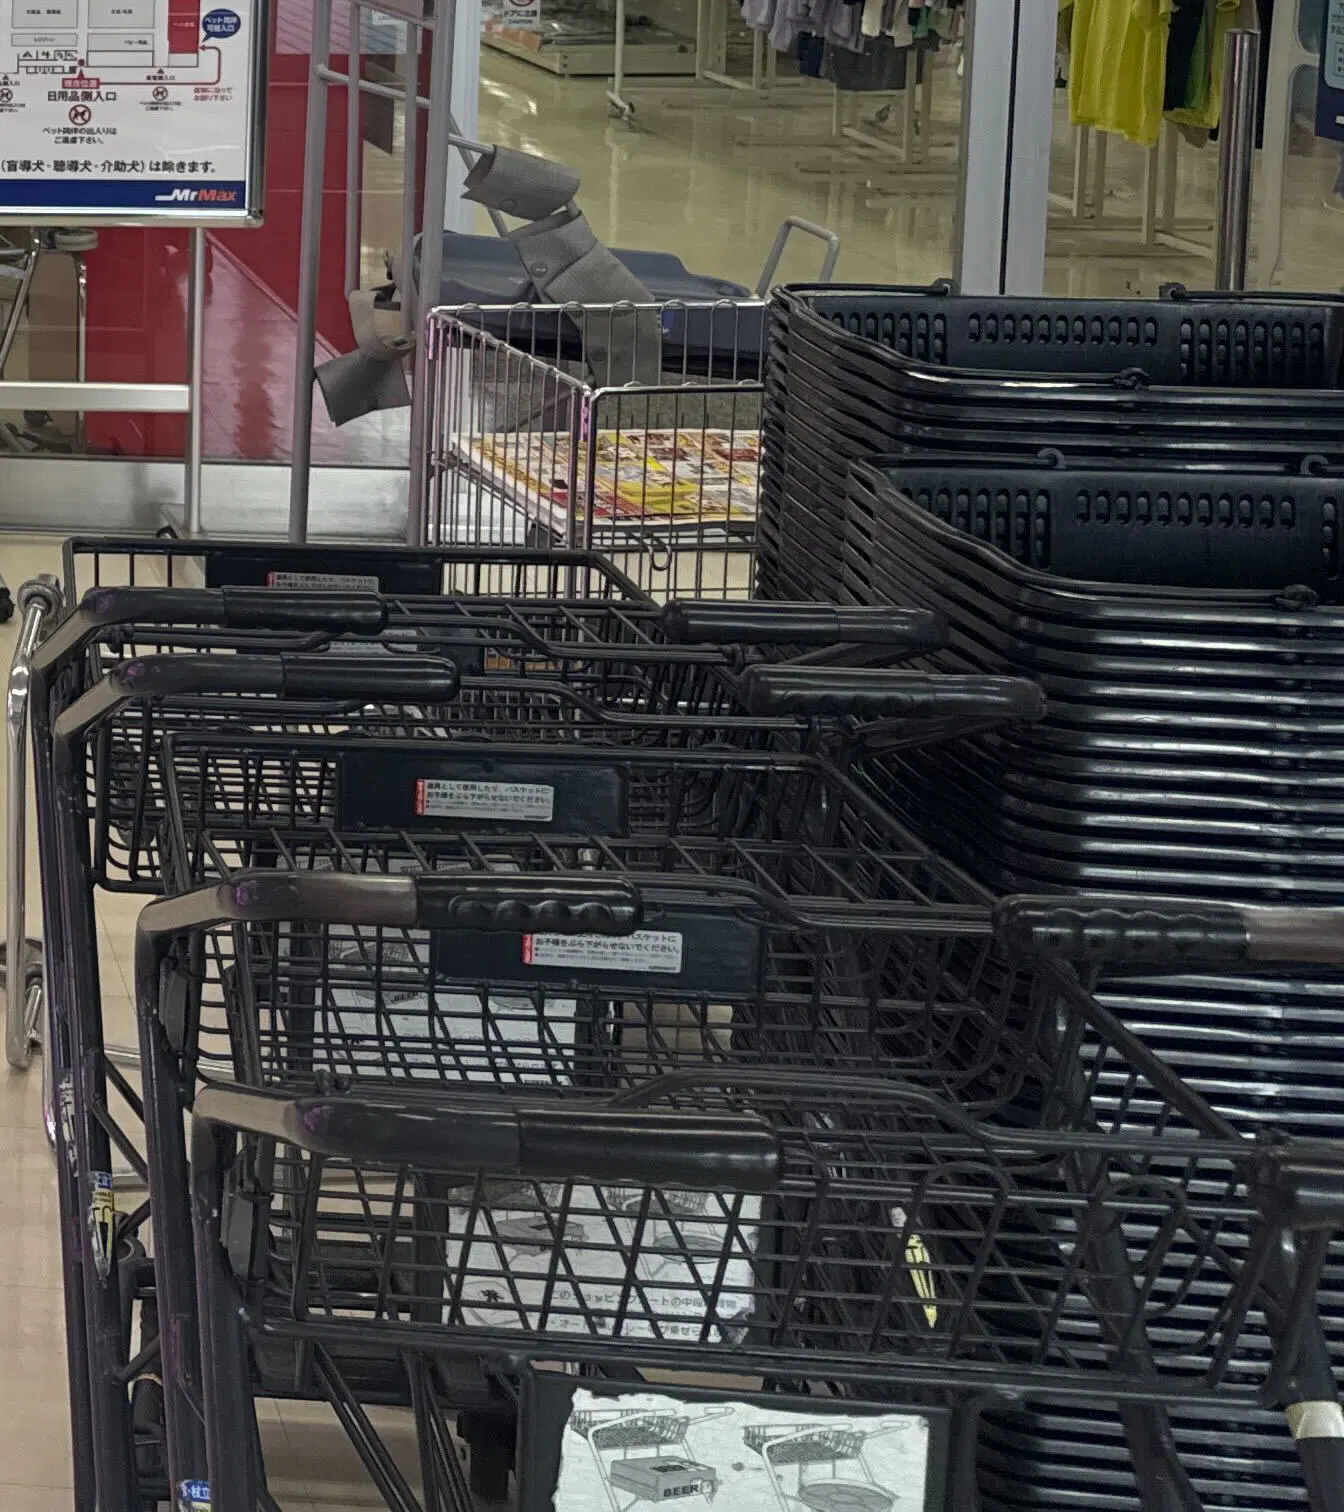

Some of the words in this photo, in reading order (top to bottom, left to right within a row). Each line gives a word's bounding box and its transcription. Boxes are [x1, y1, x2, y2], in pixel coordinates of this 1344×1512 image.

[47, 91, 117, 102] 日用品側入口
[155, 189, 236, 201] MrMax
